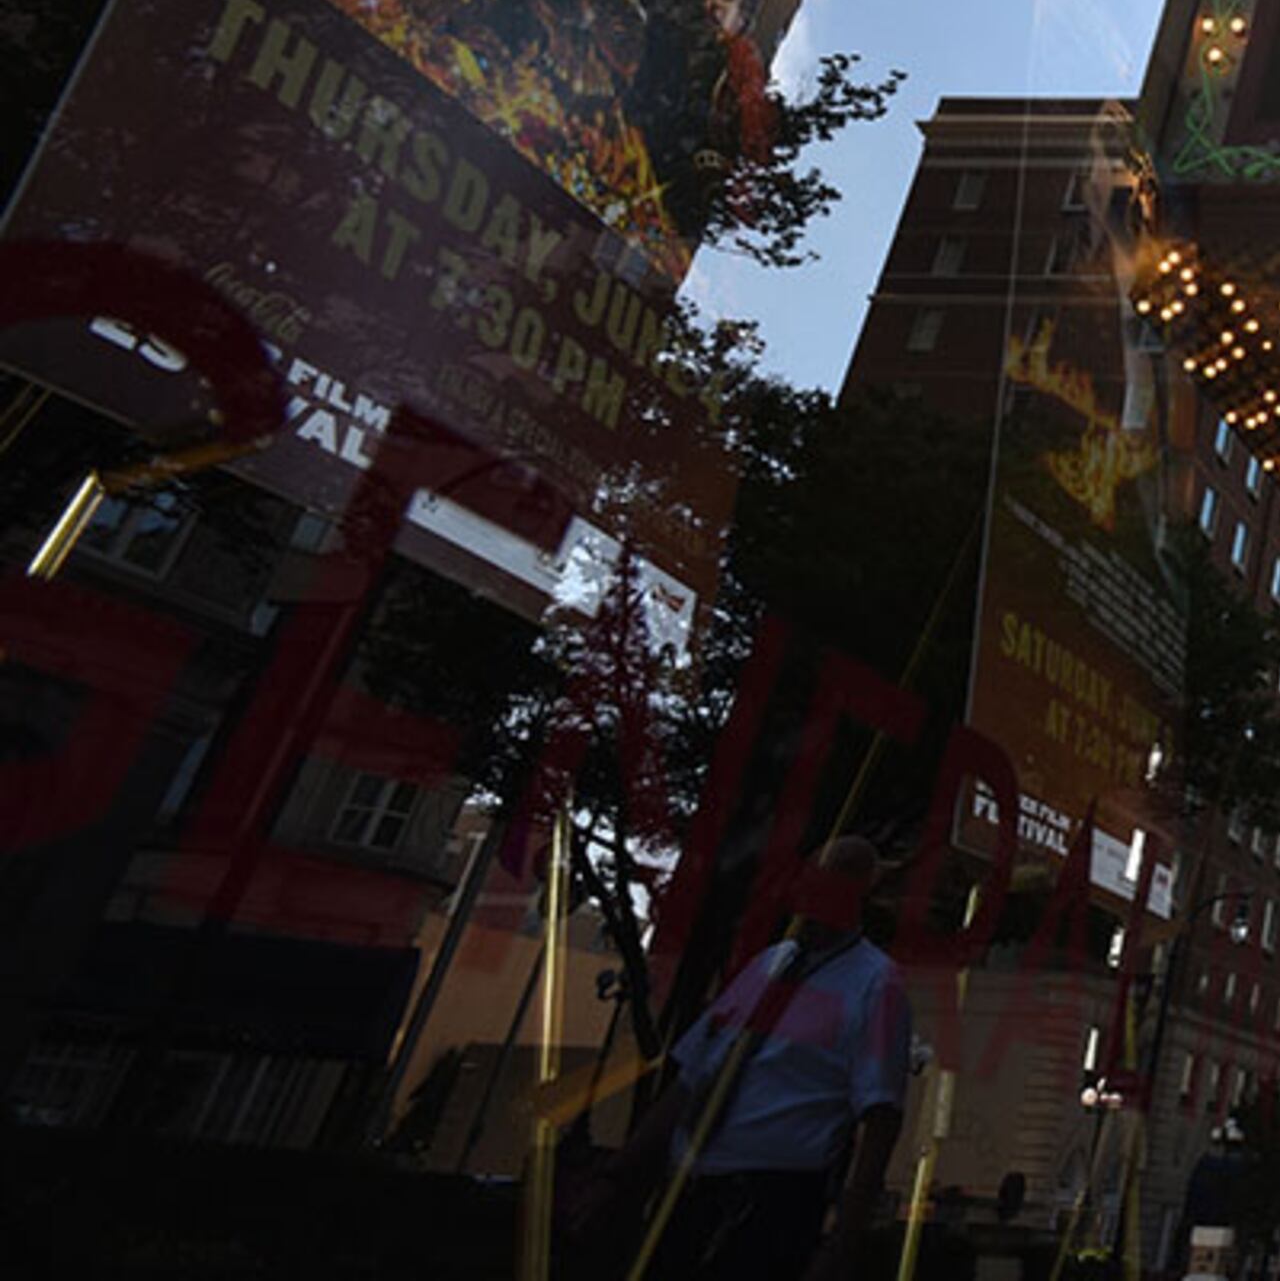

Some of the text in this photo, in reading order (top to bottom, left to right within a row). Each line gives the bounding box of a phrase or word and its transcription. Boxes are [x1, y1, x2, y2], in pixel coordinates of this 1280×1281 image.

[331, 193, 421, 281] AT
[550, 335, 627, 431] PM
[286, 356, 393, 440] FILM
